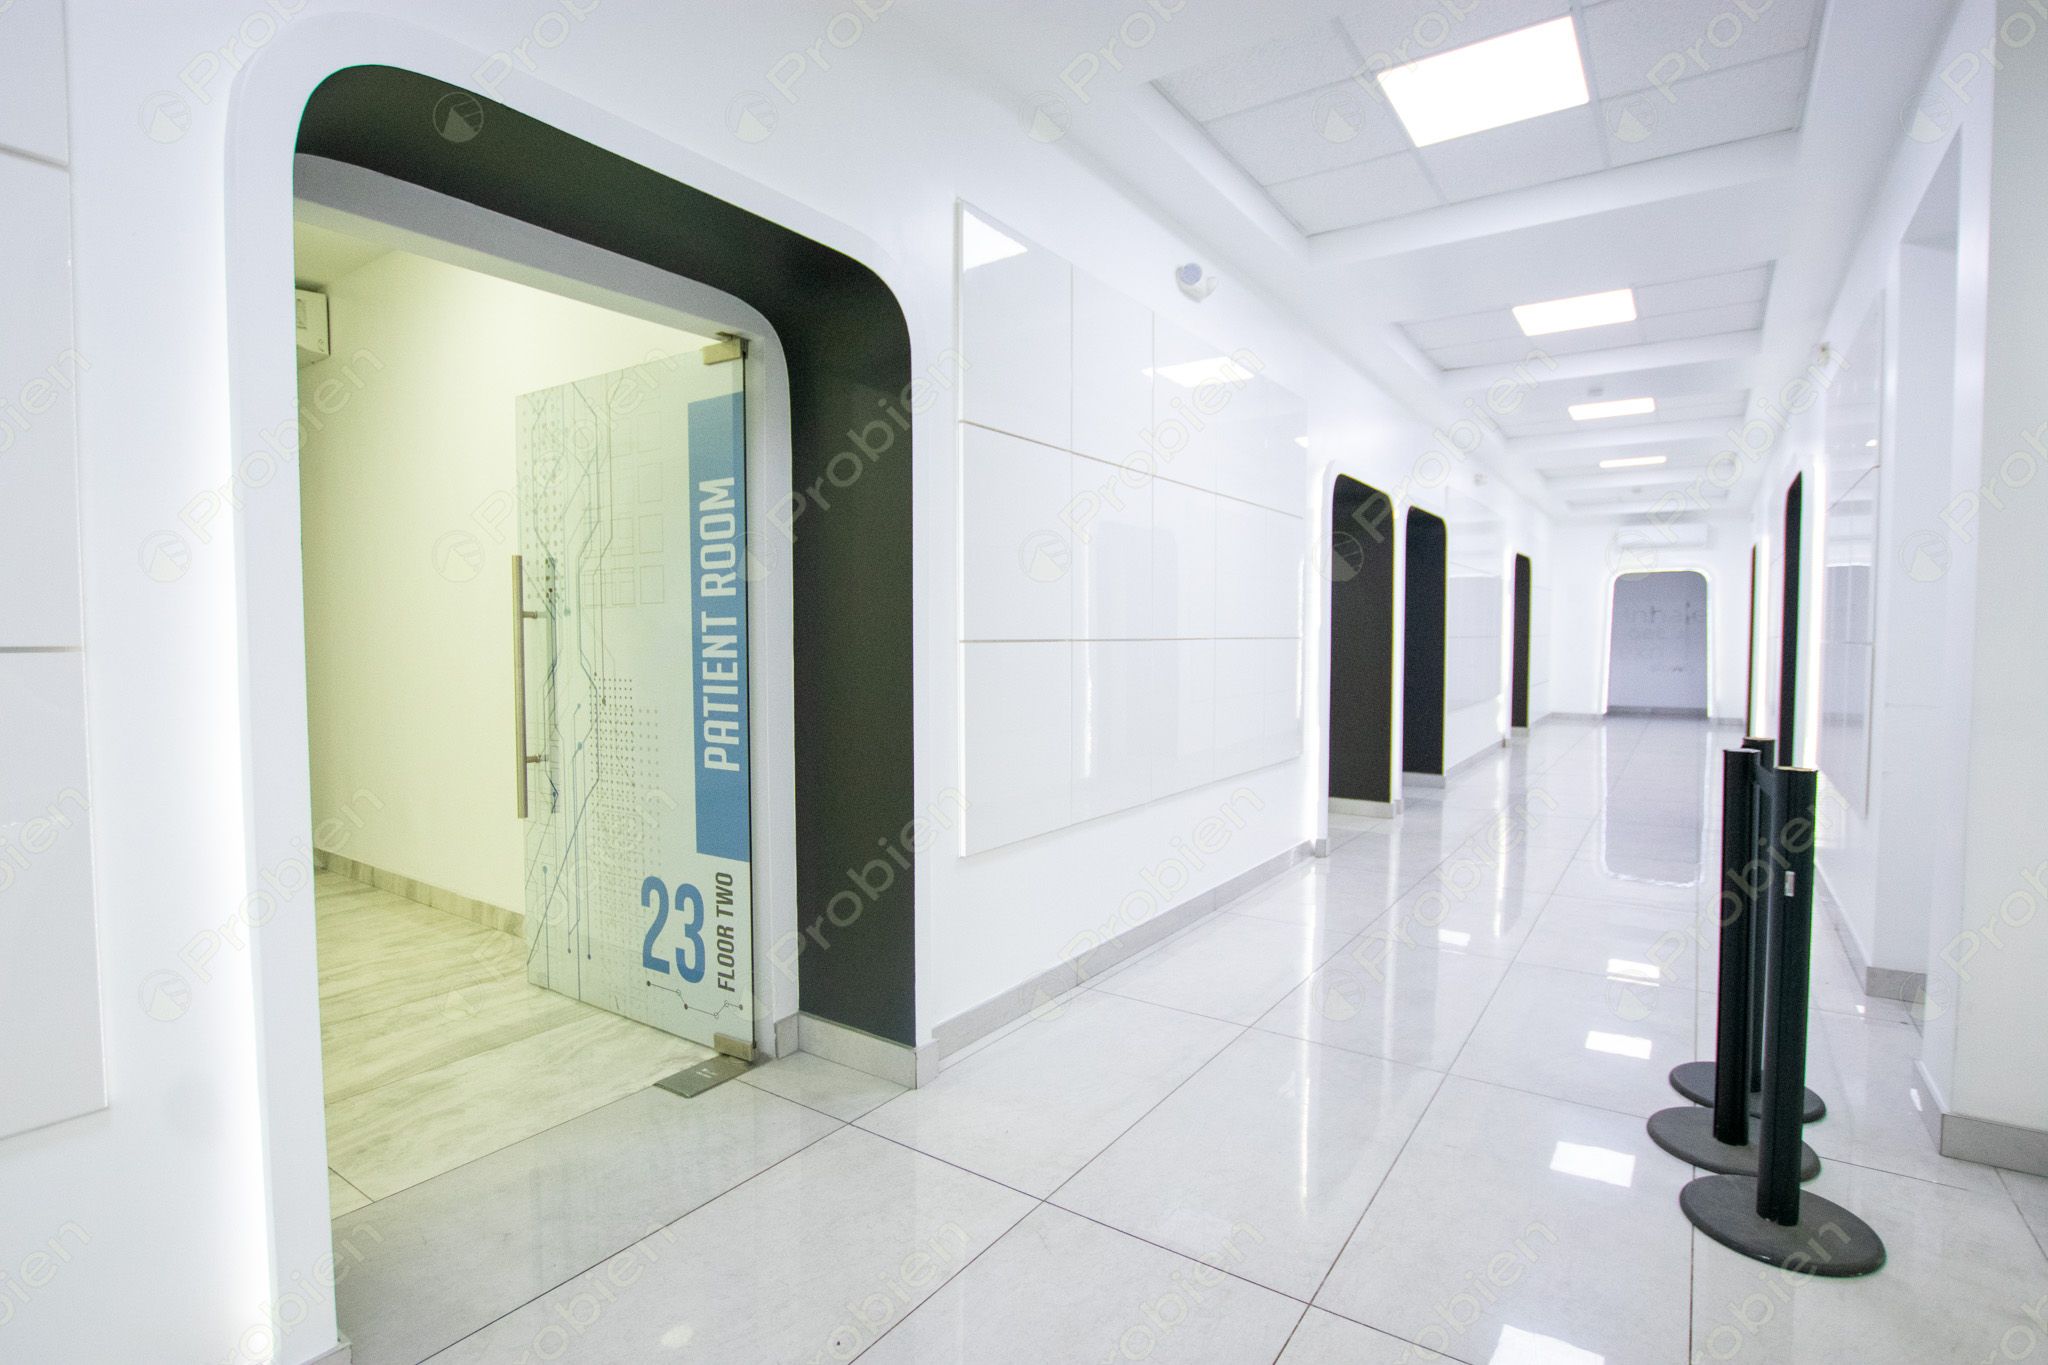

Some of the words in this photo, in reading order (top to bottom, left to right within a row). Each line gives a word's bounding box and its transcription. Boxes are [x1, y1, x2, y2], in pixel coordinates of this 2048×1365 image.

[698, 476, 737, 597] ROOM
[701, 611, 740, 771] PATIENT
[641, 875, 705, 984] 23
[715, 872, 734, 918] TWO
[716, 924, 735, 992] FLOOR
